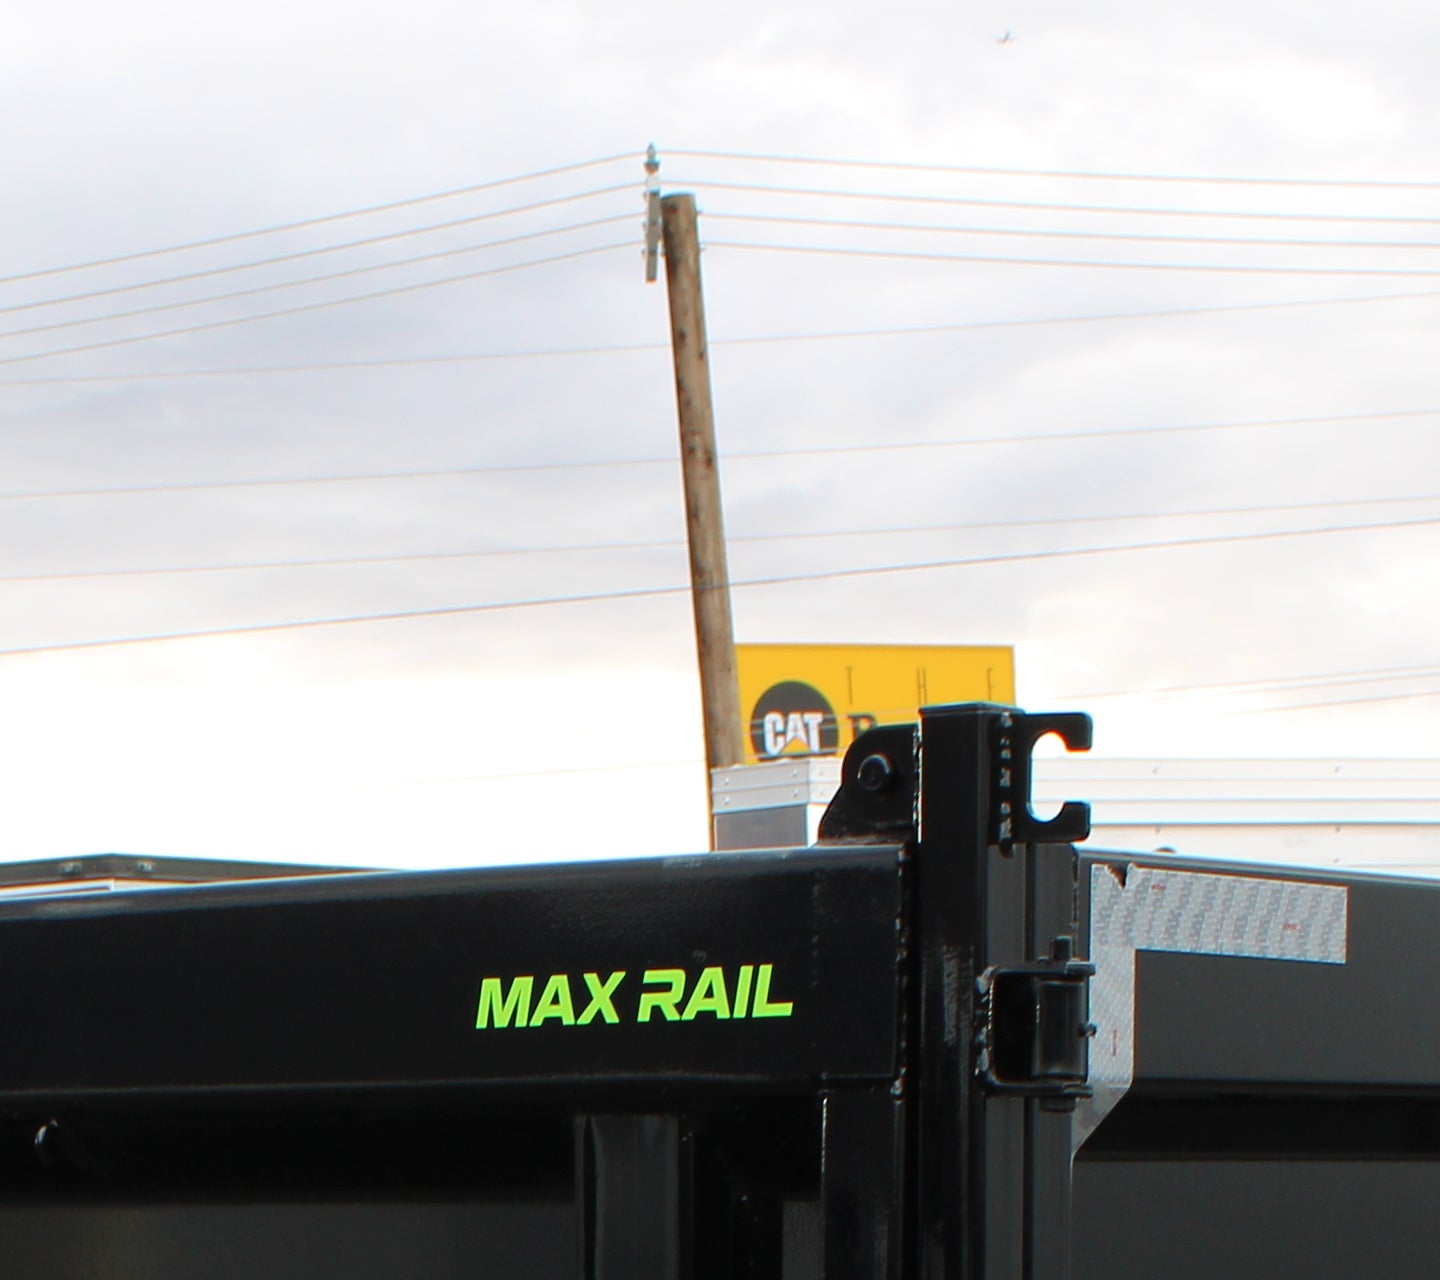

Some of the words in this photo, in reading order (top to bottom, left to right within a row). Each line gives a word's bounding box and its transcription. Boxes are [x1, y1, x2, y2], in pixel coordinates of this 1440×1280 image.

[762, 712, 824, 757] CAT
[475, 970, 627, 1029] MAX
[637, 963, 794, 1023] RAIL
